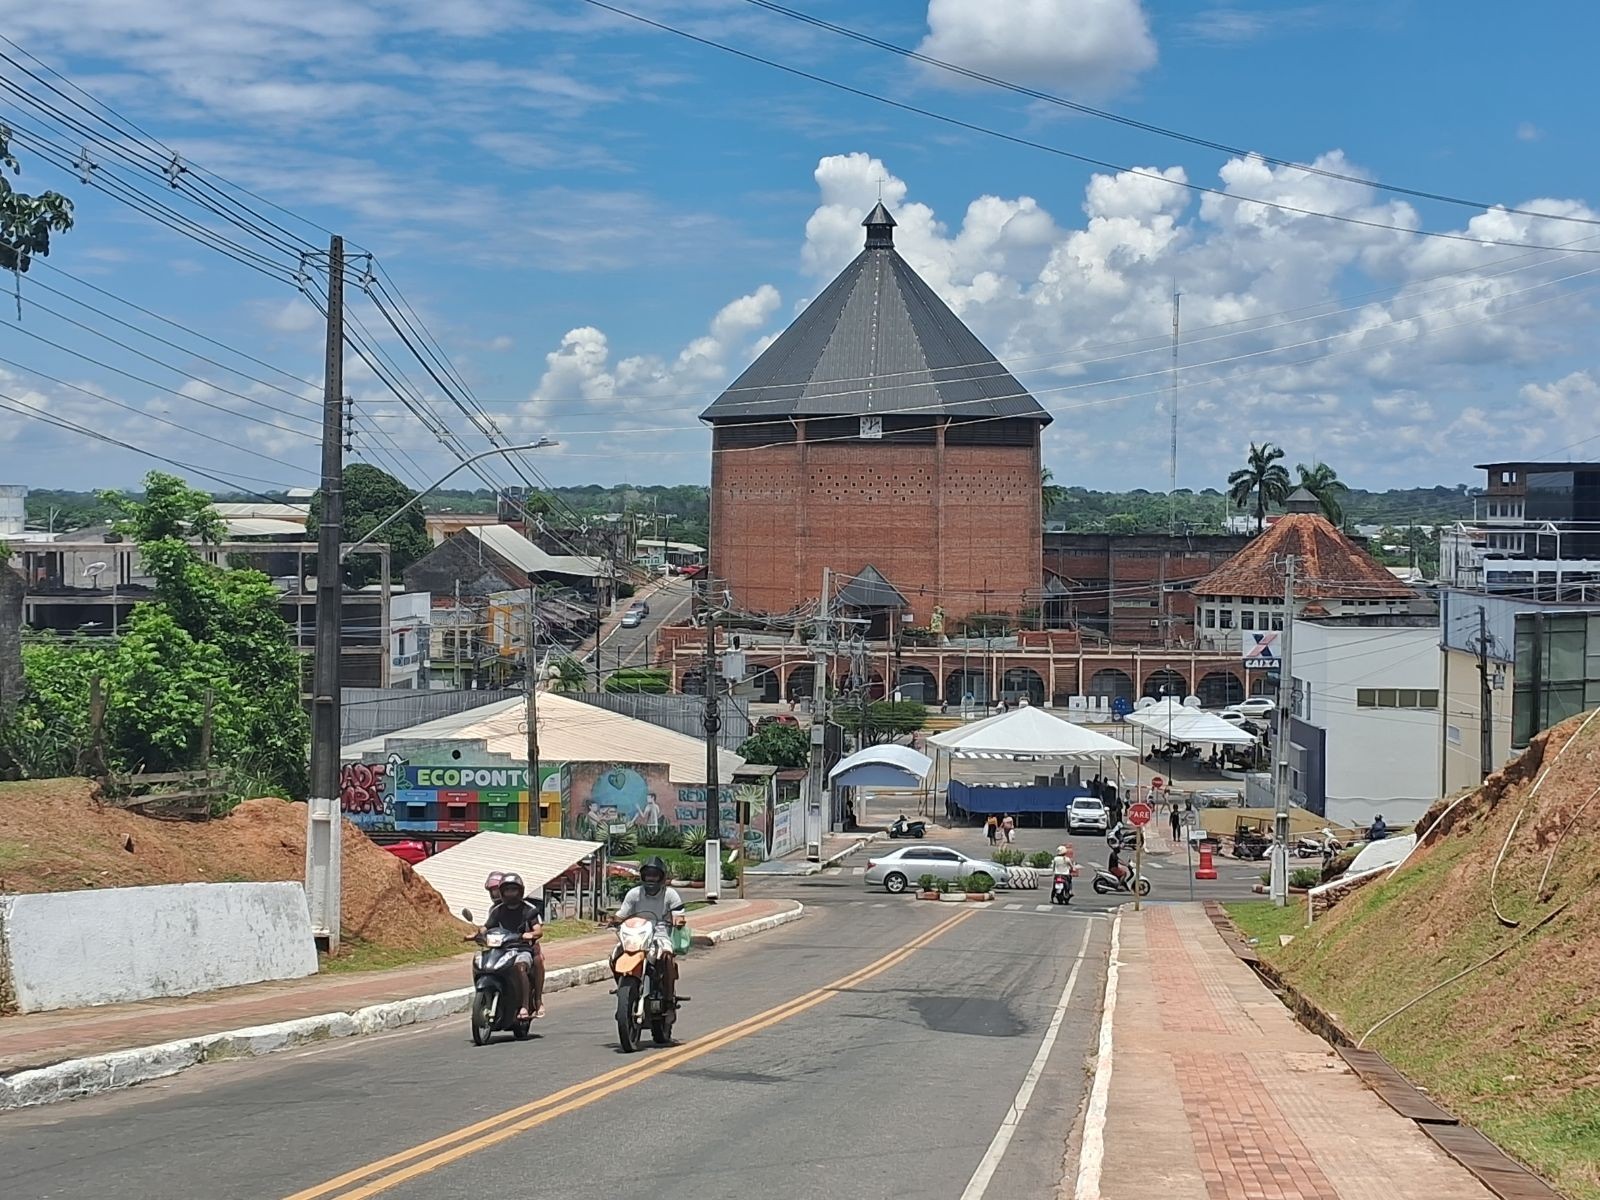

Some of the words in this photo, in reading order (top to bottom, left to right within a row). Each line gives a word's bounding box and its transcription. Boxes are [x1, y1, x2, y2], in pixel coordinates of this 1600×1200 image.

[1245, 659, 1280, 668] CAIXA
[340, 763, 386, 792] ADE
[1129, 810, 1150, 819] PARE
